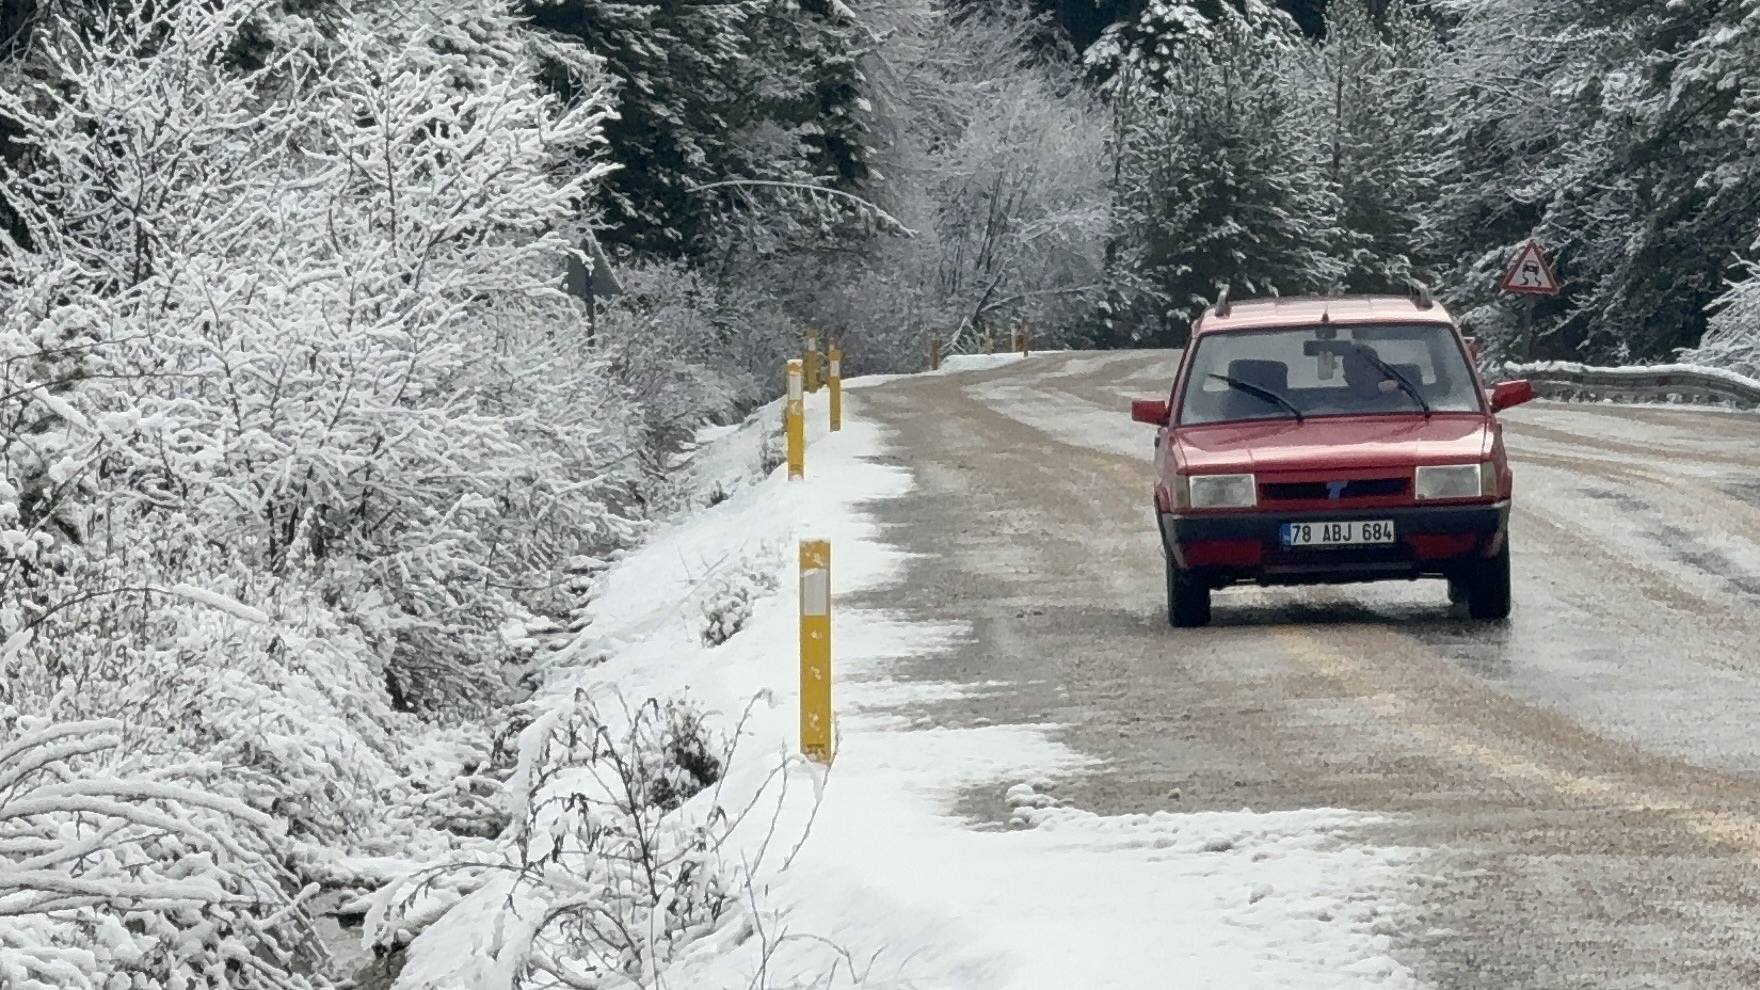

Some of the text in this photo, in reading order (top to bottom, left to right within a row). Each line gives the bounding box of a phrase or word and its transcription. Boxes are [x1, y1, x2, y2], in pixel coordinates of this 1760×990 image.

[1292, 522, 1392, 543] 78 ABJ 684
